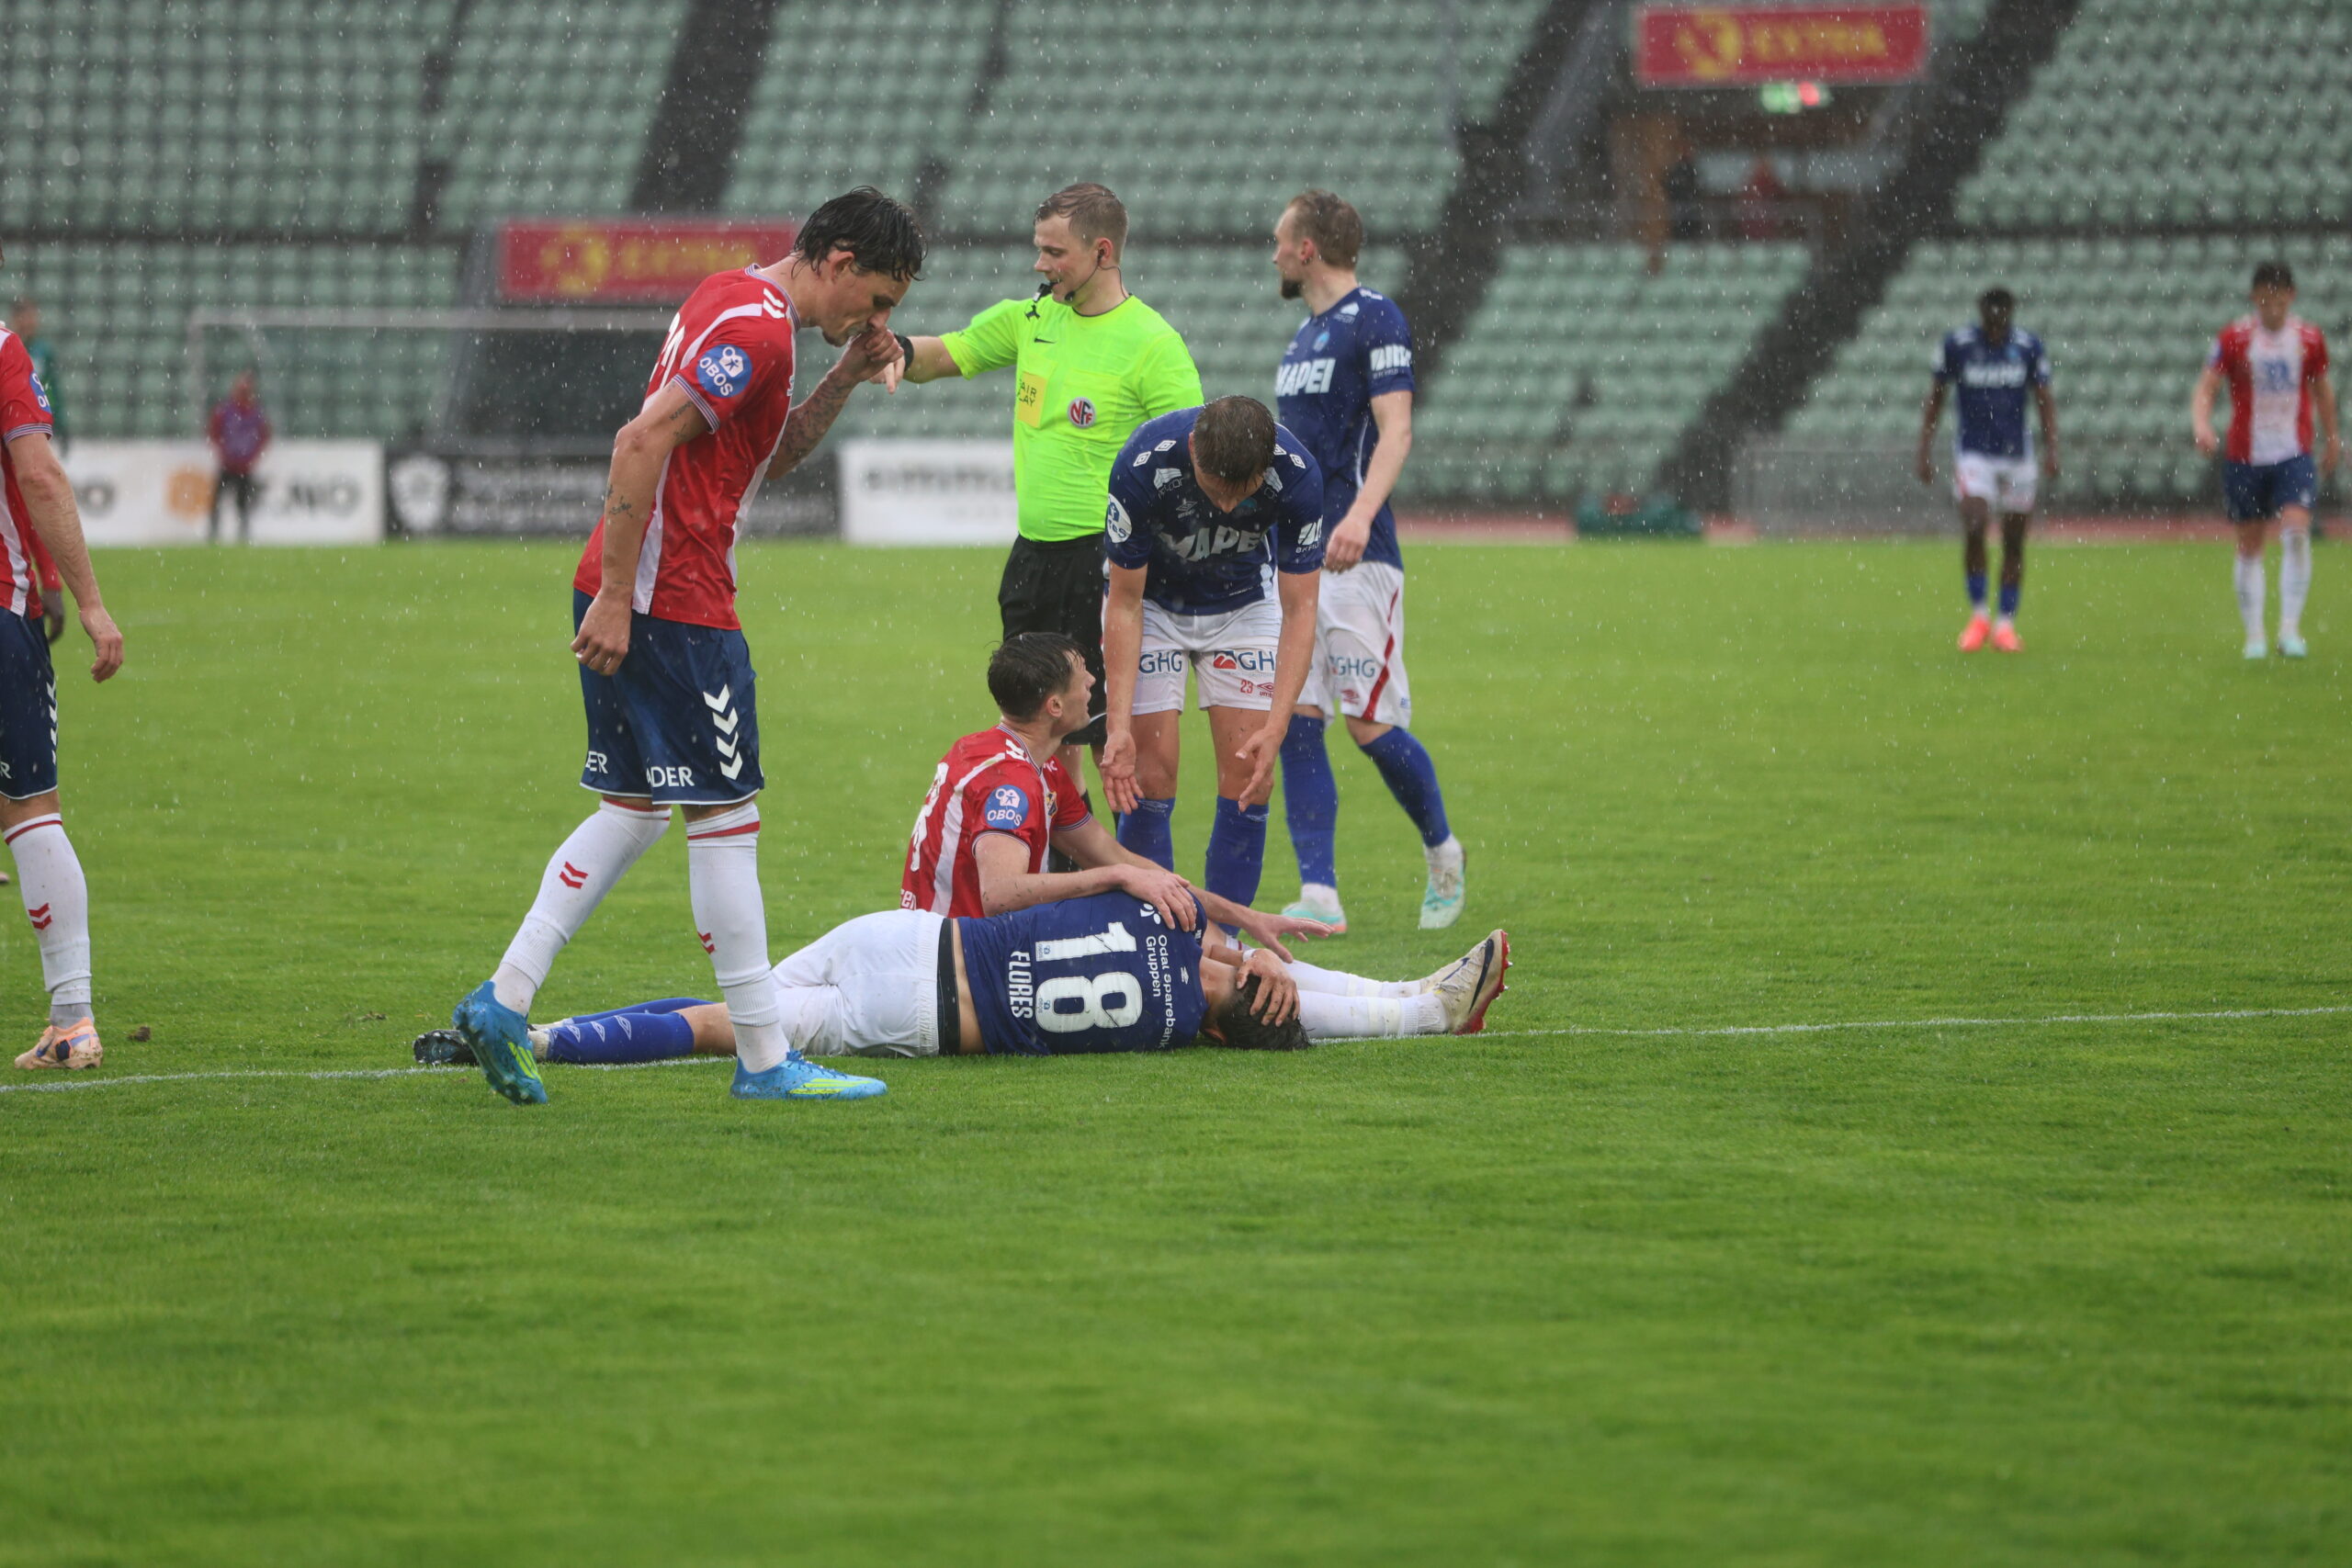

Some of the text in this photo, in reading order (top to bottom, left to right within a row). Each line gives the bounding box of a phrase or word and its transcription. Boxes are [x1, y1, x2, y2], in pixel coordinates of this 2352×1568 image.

[699, 356, 733, 396] OBOS
[1069, 400, 1093, 424] NFF
[1158, 525, 1262, 562] MAPE
[1139, 650, 1183, 674] GHG
[1238, 650, 1275, 671] GH
[1337, 656, 1376, 678] GHG
[1239, 679, 1254, 694] 23
[987, 808, 1023, 828] OBOS
[1146, 936, 1161, 998] Gruppen
[1158, 934, 1170, 970] Odal
[1008, 950, 1035, 1020] FLORES
[1035, 921, 1143, 1033] 18
